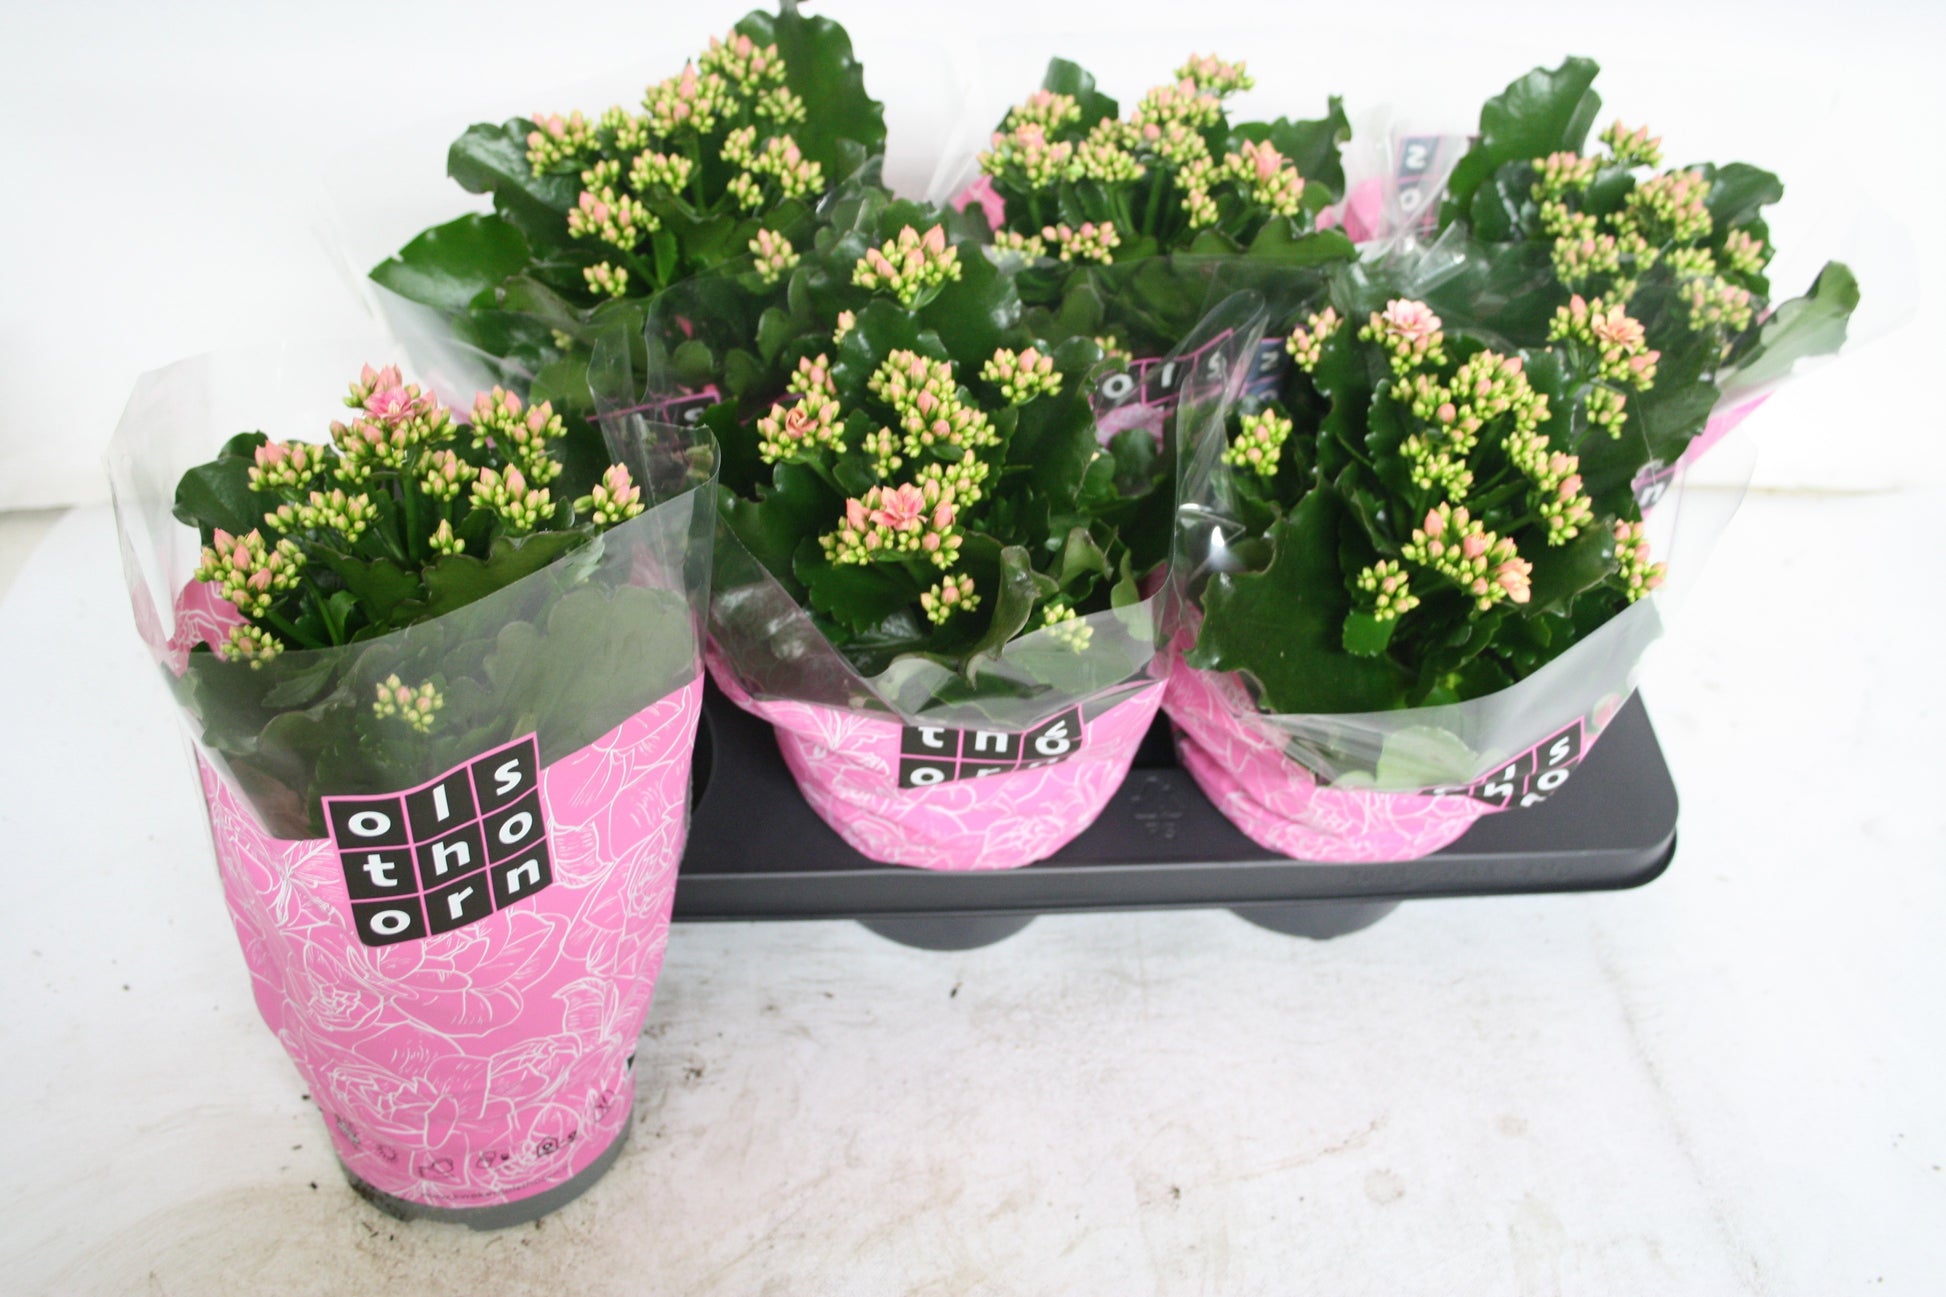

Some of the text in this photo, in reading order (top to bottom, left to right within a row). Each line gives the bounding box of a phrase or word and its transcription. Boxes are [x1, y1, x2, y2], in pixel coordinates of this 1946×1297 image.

[348, 758, 523, 838] ols
[362, 811, 533, 888] tho
[369, 858, 542, 936] orn
